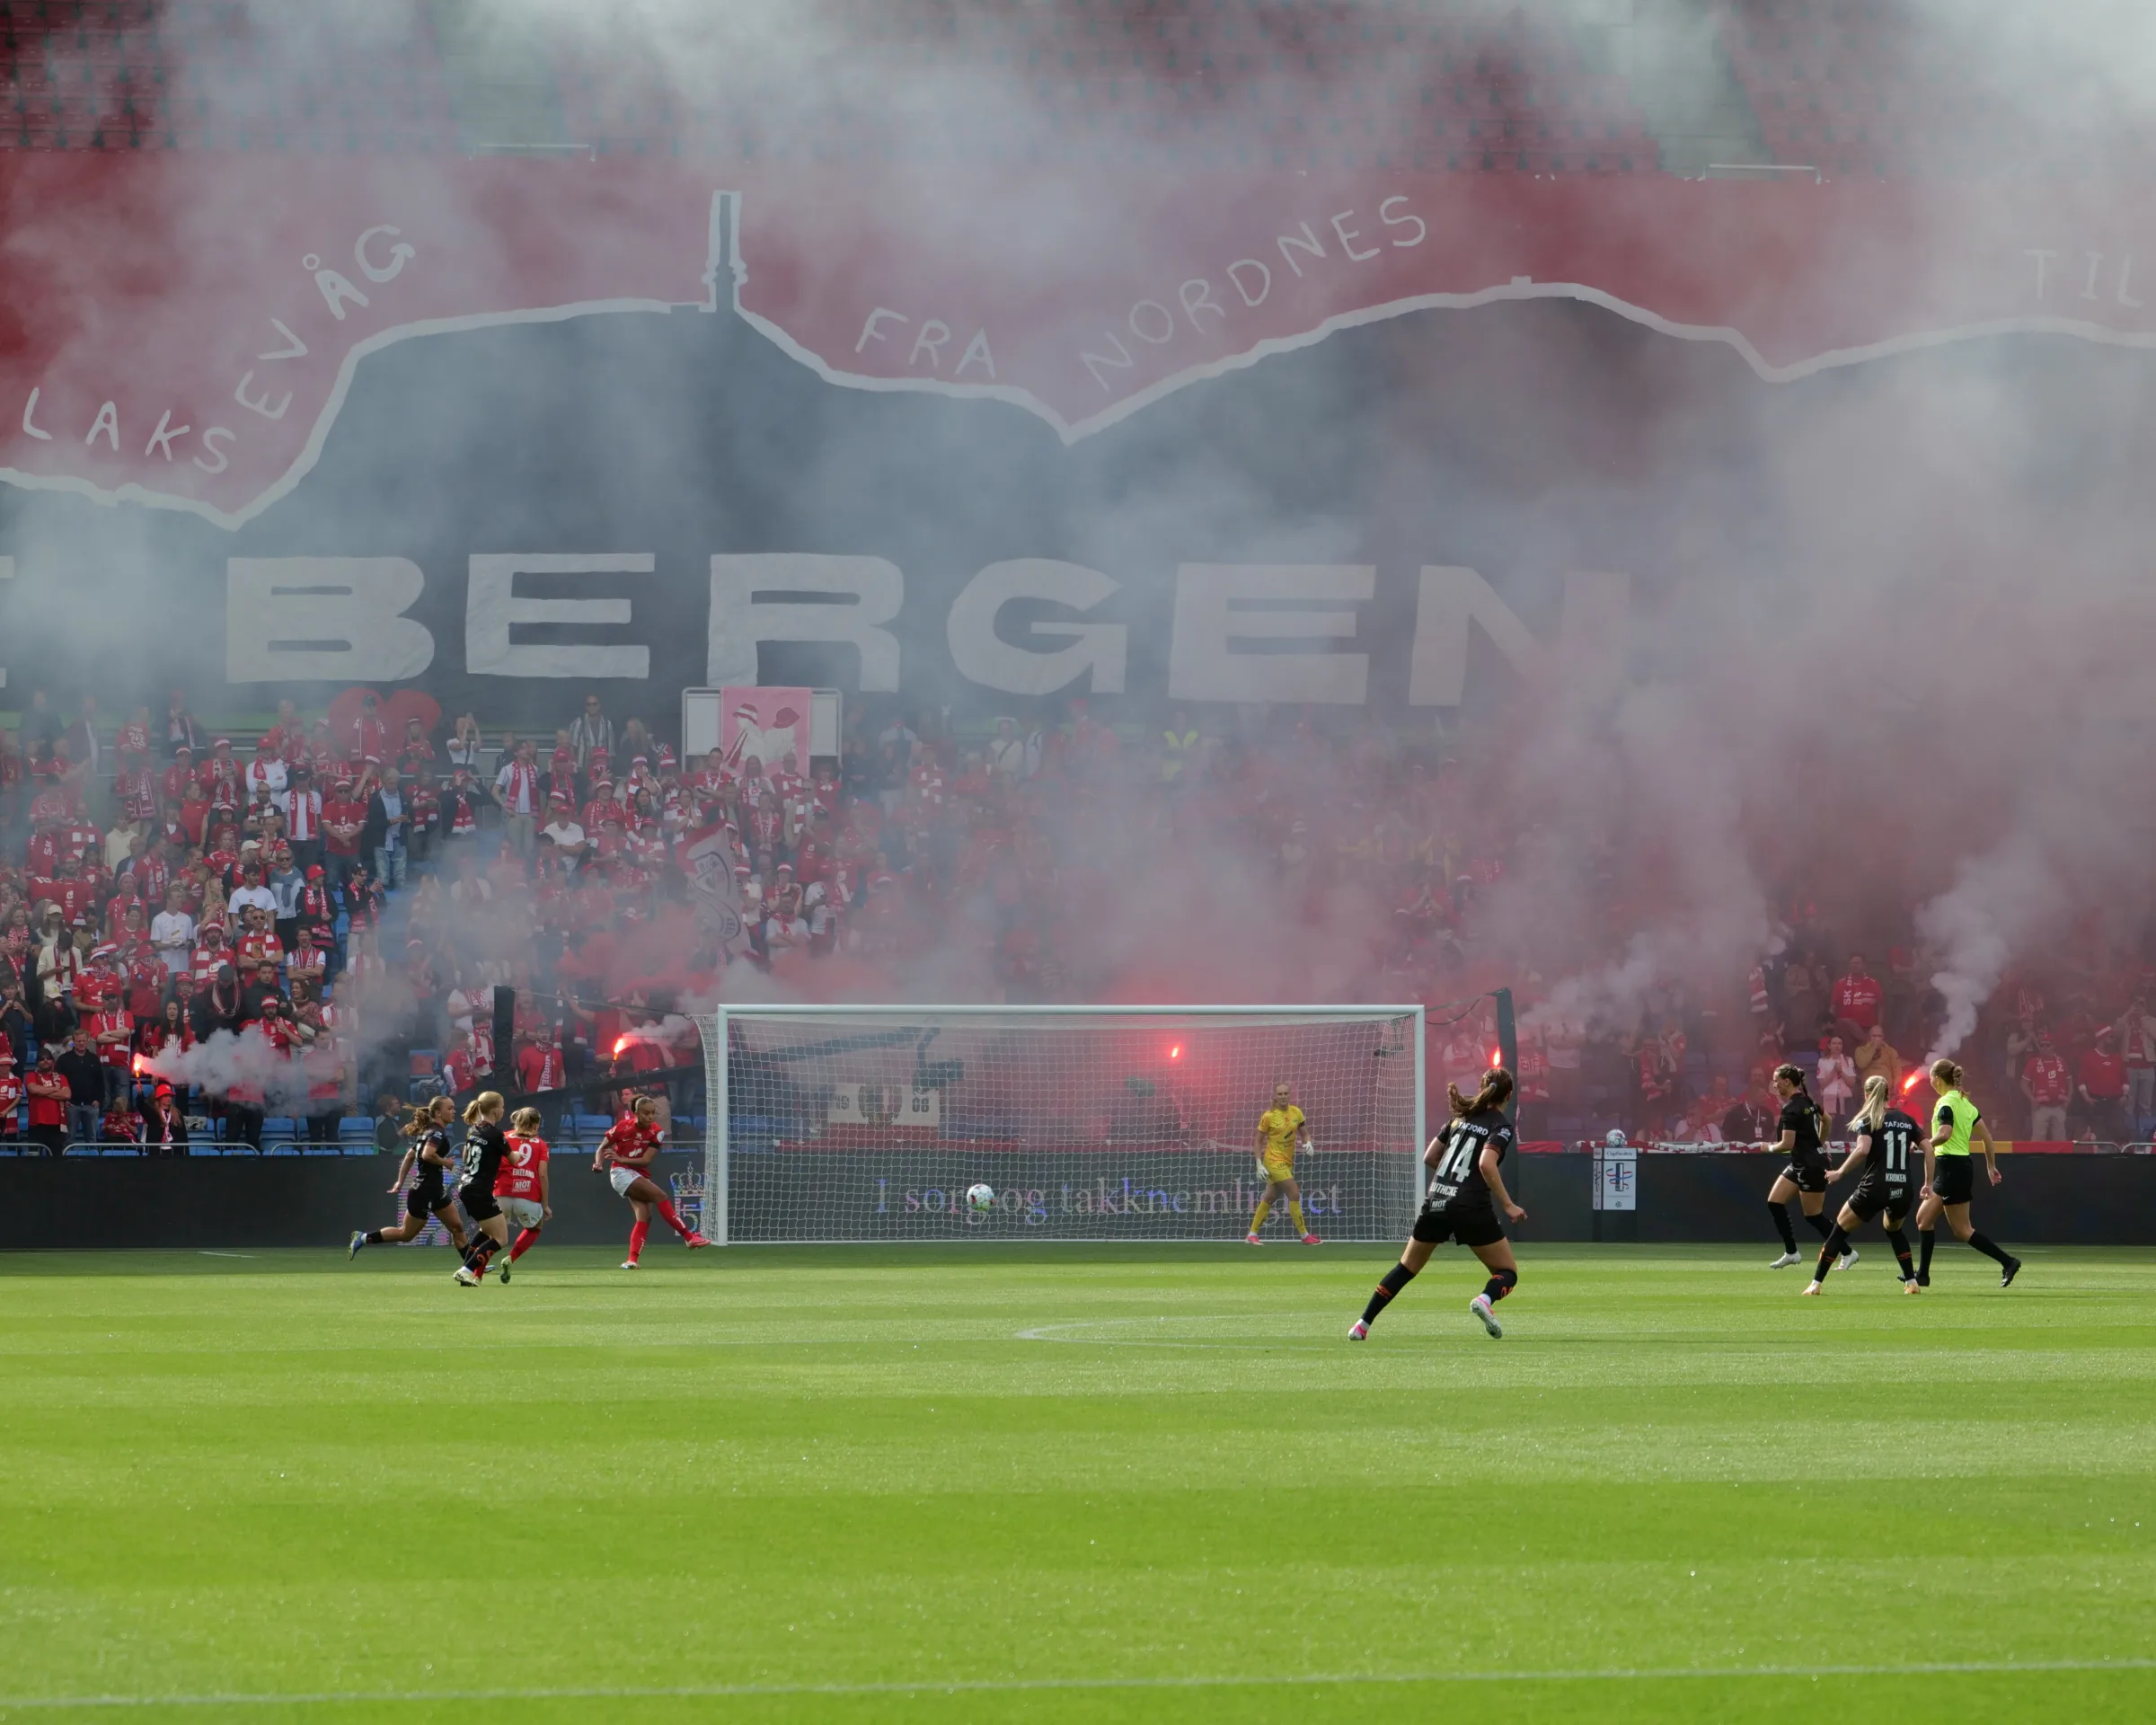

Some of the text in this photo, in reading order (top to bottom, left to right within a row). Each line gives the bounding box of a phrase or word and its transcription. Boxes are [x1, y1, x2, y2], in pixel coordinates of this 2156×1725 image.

[2023, 248, 2145, 307] TIL
[855, 195, 1427, 392] FRA NORDNES
[23, 224, 416, 474] LAKSEVÅG
[226, 552, 1630, 708] BERGEN
[912, 1097, 930, 1113] 08
[1458, 1121, 1489, 1136] TAFJORD
[1884, 1120, 1913, 1130] TAFJORD
[517, 1143, 533, 1167] 9
[1436, 1133, 1478, 1183] 14
[1883, 1130, 1907, 1171] 11
[515, 1181, 531, 1189] MOT
[1885, 1172, 1907, 1183] KROKEN
[875, 1178, 888, 1213] I
[1000, 1189, 1048, 1226] og
[1431, 1200, 1446, 1208] MOT
[1890, 1189, 1903, 1197] MOT
